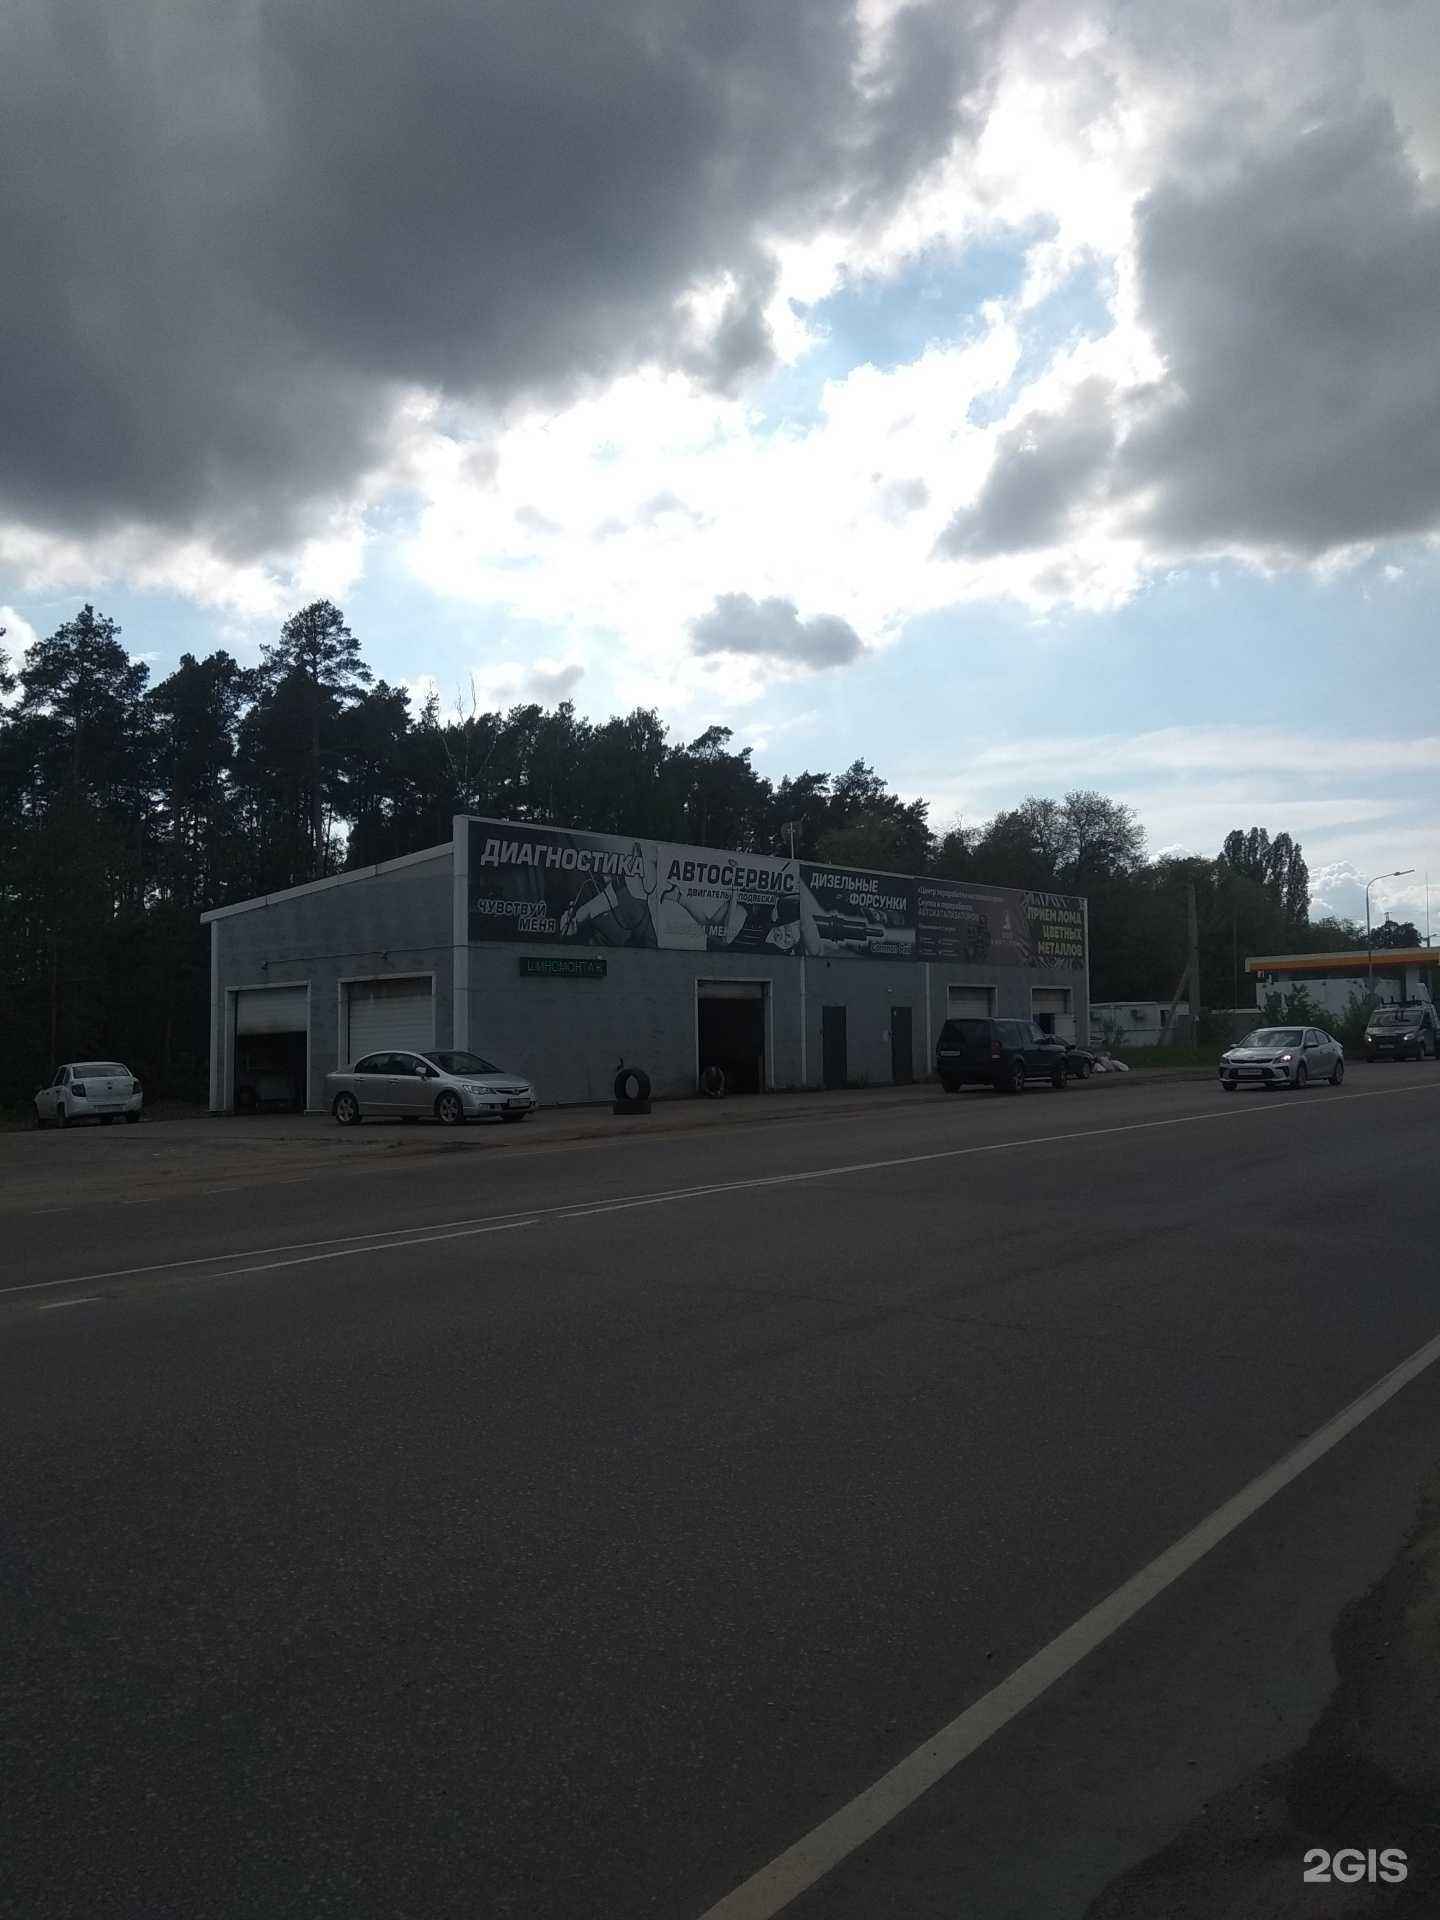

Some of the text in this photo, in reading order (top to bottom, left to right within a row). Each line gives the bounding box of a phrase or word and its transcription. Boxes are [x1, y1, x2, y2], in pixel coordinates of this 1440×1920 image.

[480, 838, 645, 878] ДИАГНОСТИКА
[667, 859, 795, 892] АВТОСЕРВИС
[810, 872, 879, 893] ДИЗЕЛЬНЫЕ
[479, 899, 547, 918] ЧУВСТВУЙ
[849, 893, 907, 912] ФОРСУНКИ
[519, 918, 556, 933] МЕНЯ
